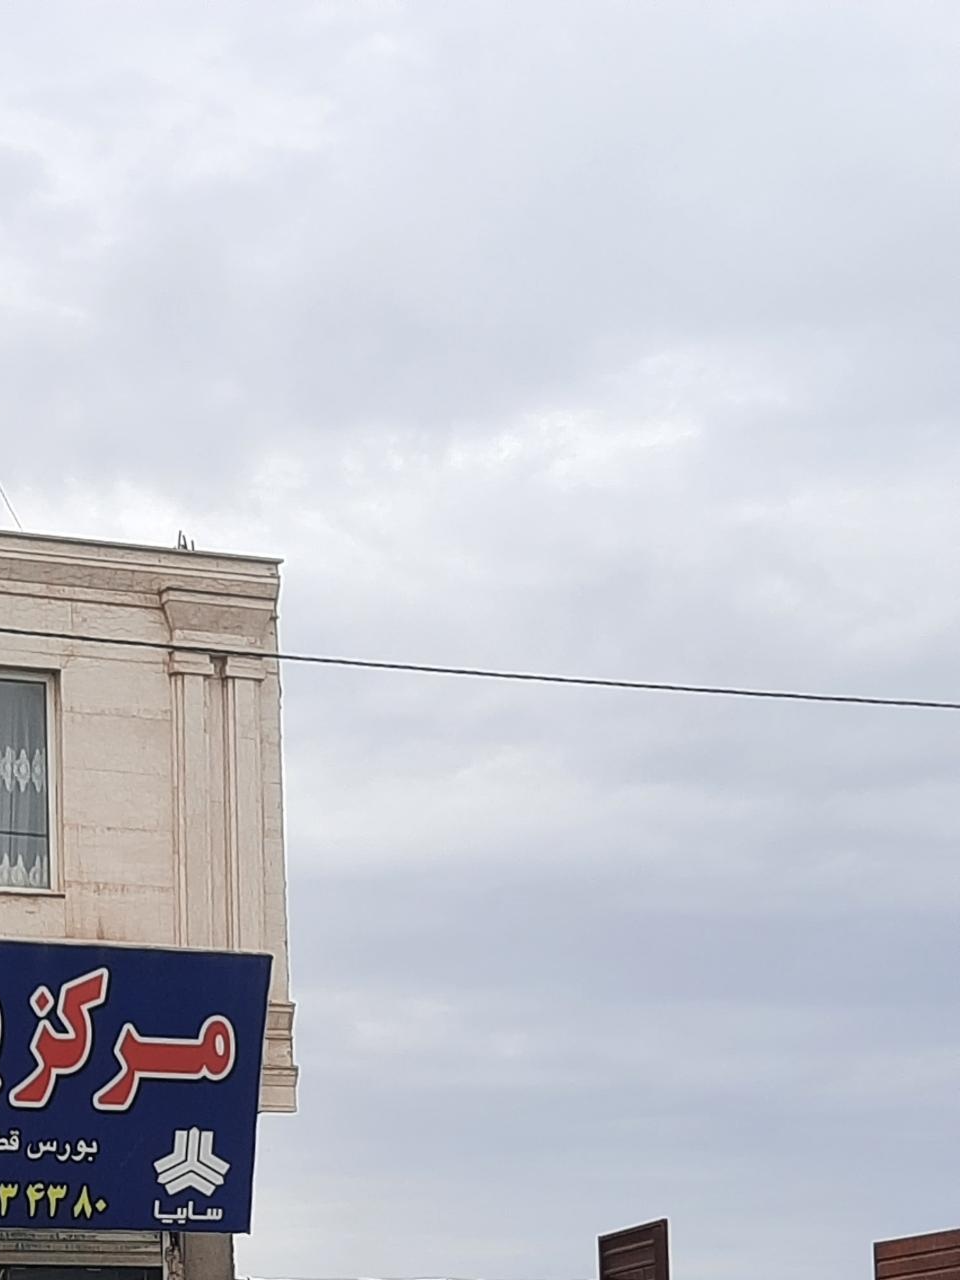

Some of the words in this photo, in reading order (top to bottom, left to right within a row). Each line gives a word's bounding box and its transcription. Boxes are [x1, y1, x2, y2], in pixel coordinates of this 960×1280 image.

[9, 968, 235, 1110] مرکز
[27, 1140, 97, 1161] بورس
[154, 1200, 222, 1223] سایپا
